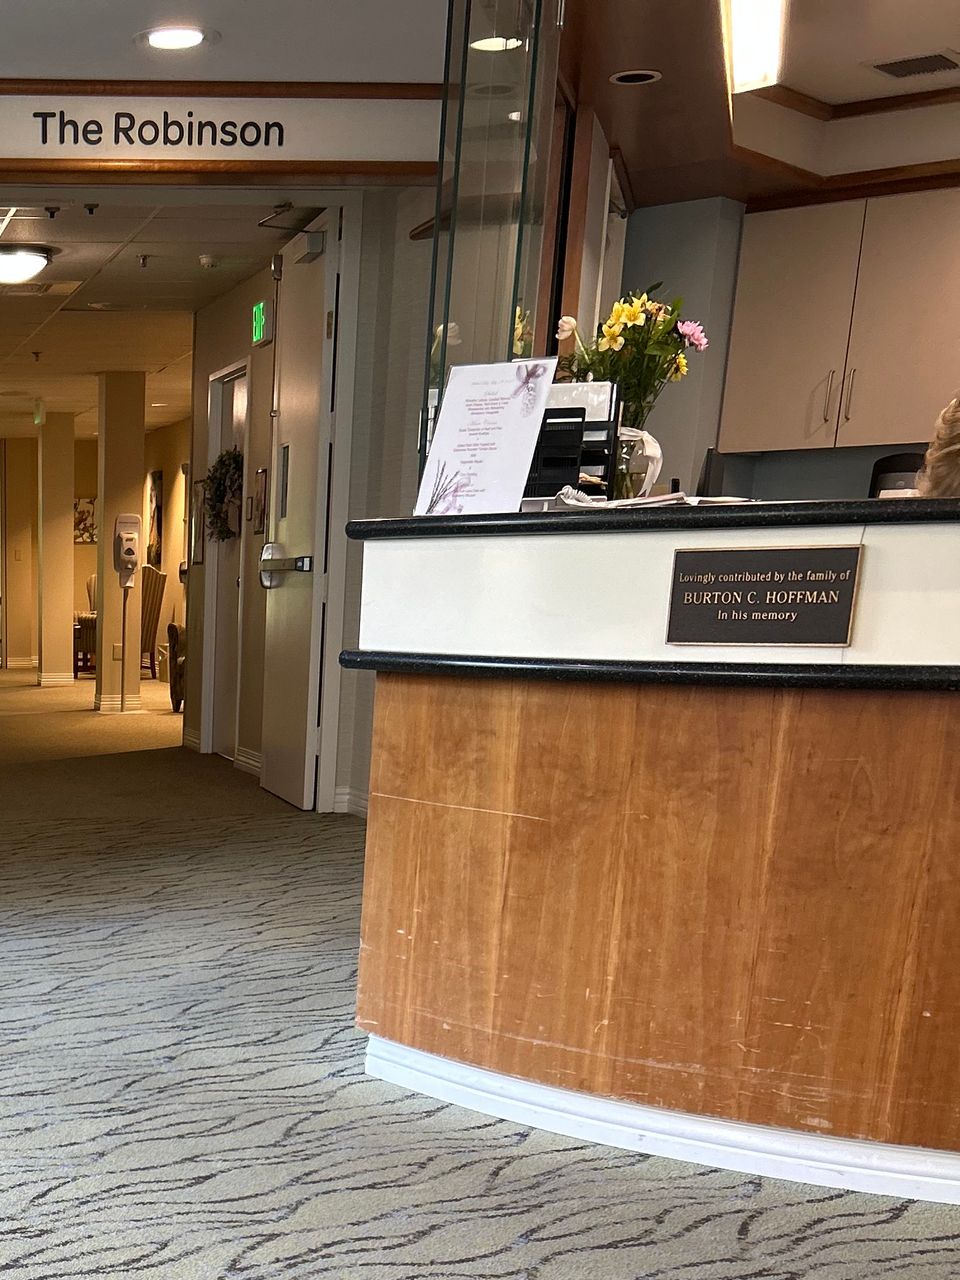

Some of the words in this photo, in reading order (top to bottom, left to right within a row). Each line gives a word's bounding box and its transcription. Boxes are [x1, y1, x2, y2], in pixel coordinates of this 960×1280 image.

[32, 110, 103, 146] The
[113, 110, 285, 147] Robinson
[679, 572, 716, 585] Lovingly
[718, 571, 771, 583] contributed
[773, 571, 785, 584] by
[787, 571, 803, 582] the
[806, 570, 837, 583] family
[839, 569, 851, 581] of
[683, 591, 743, 605] BURTON
[746, 591, 760, 605] C.
[765, 590, 840, 605] HOFFMAN
[717, 609, 728, 620] In
[731, 609, 748, 620] his
[751, 610, 798, 622] memory
